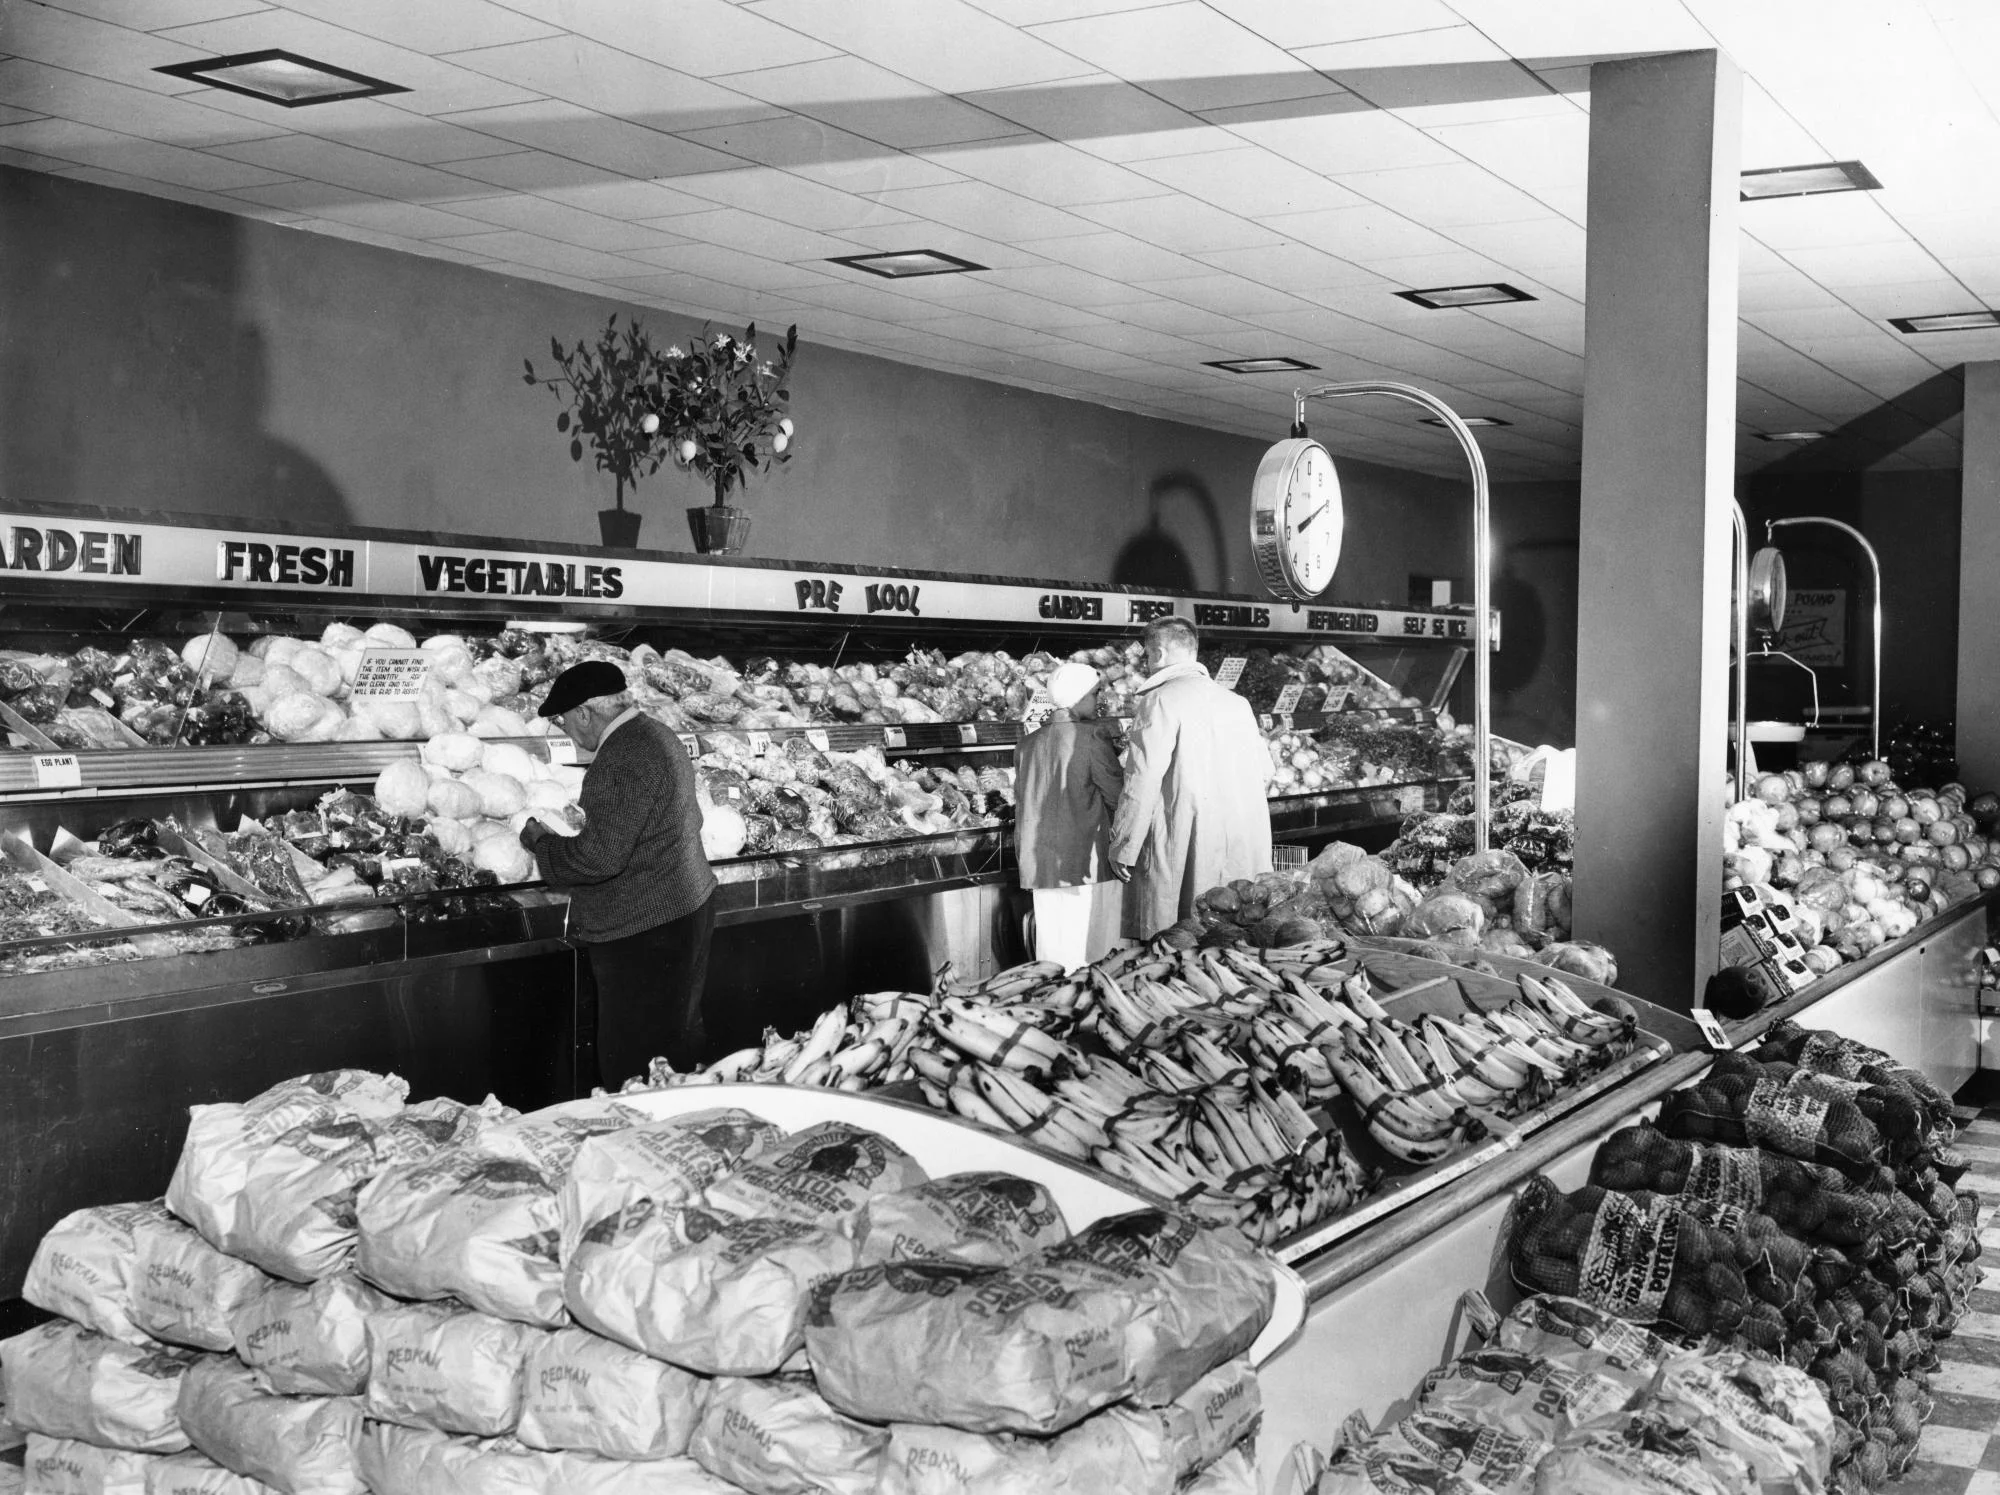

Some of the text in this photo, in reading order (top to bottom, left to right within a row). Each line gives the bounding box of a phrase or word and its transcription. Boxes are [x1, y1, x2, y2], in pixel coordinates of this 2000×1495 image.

[0, 526, 623, 598] RDEN FRESH VEGETABLES
[794, 579, 920, 616] PRE KOOL
[1038, 595, 1103, 621] GARDEN
[1403, 617, 1426, 635] SELF
[40, 757, 73, 767] EGG PLANT
[51, 1252, 99, 1285] REDMAN
[149, 1264, 195, 1289] REDMAN
[246, 1319, 292, 1359] REDMAN
[386, 1349, 442, 1376] REDMAN
[540, 1365, 592, 1398] REDMAN
[1204, 1383, 1245, 1430] REDMAN
[722, 1408, 773, 1452] REDMAN
[34, 1458, 84, 1482] REDMAN
[906, 1447, 971, 1485] REDMAN
